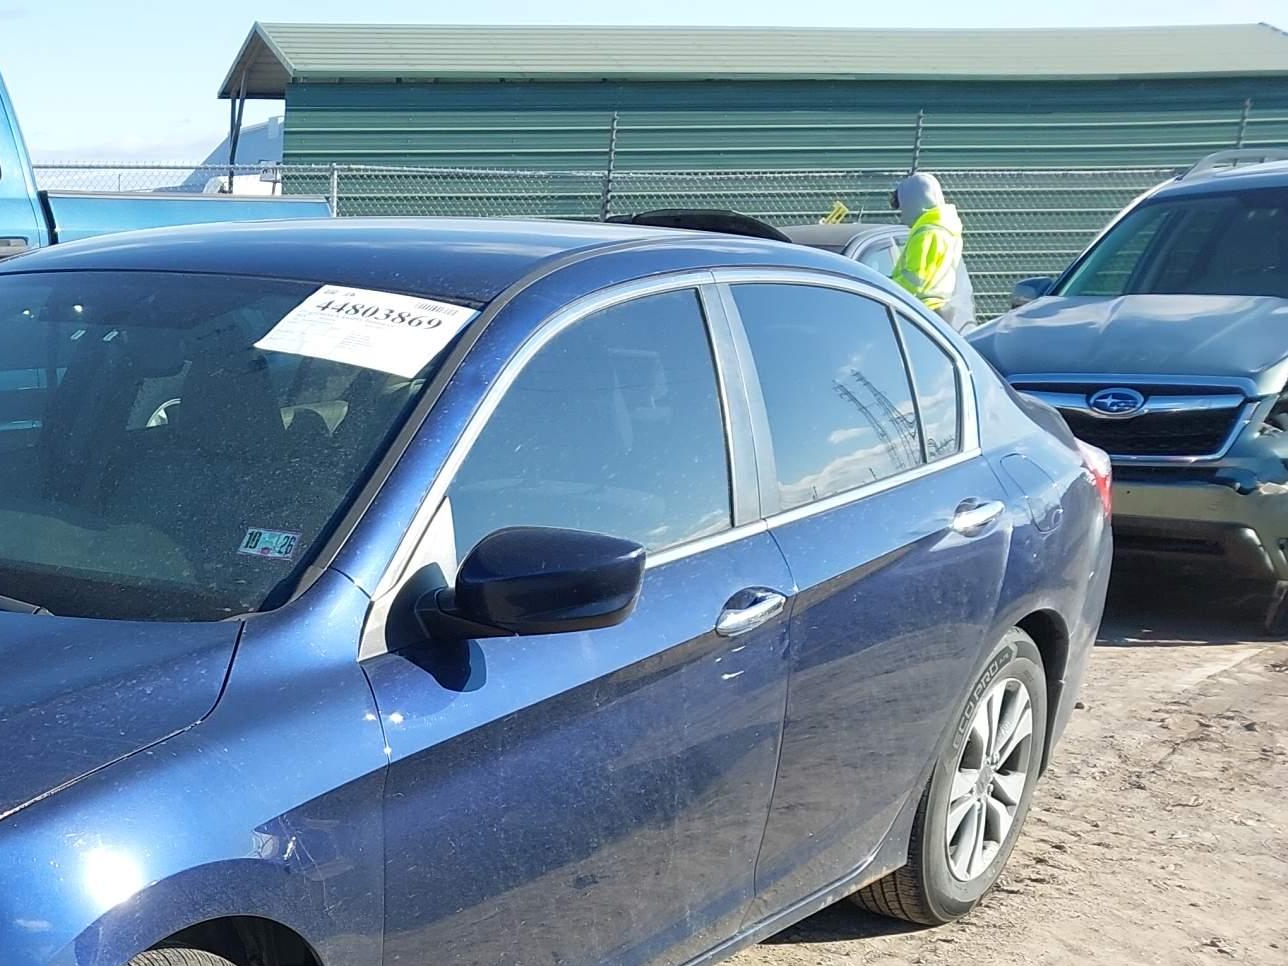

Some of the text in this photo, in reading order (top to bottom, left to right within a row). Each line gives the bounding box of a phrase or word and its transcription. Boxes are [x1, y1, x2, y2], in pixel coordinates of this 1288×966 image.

[315, 299, 443, 330] 44803869
[244, 530, 263, 549] 10
[973, 660, 999, 701] PRO
